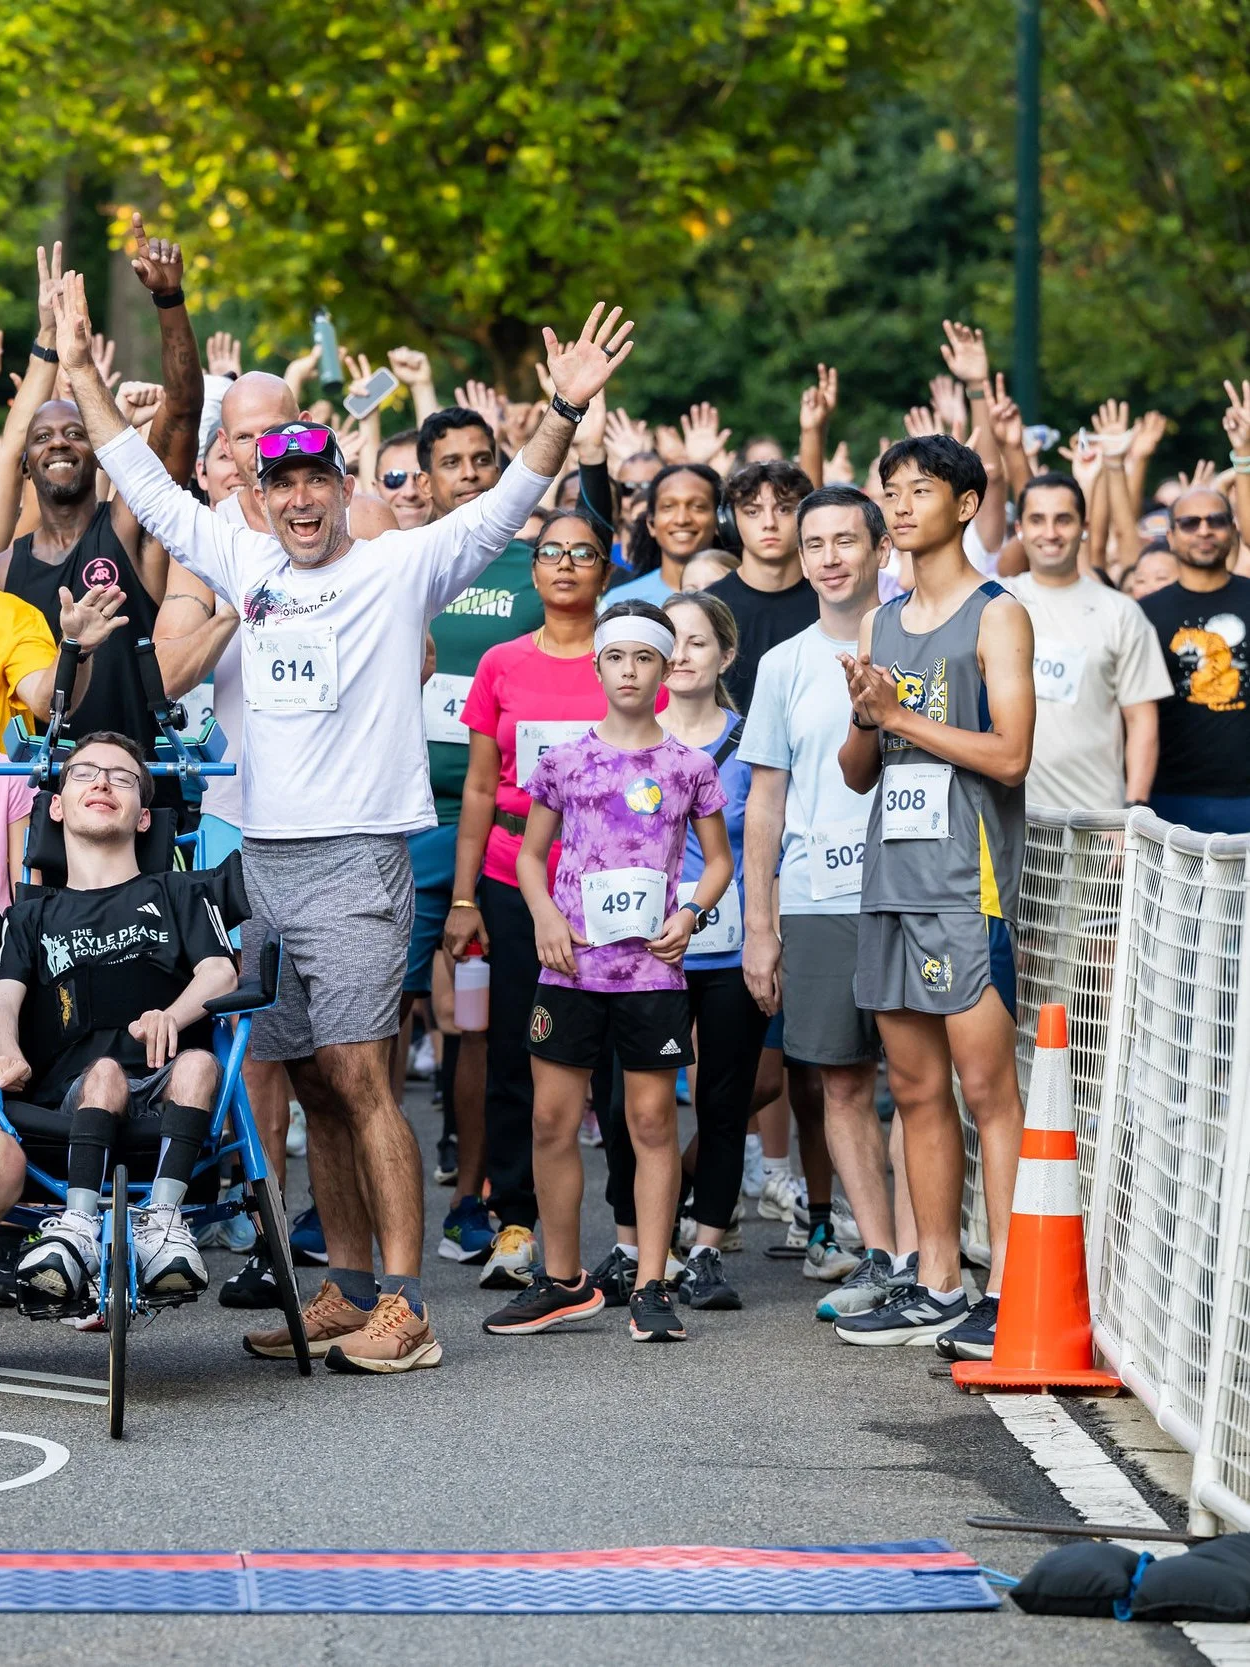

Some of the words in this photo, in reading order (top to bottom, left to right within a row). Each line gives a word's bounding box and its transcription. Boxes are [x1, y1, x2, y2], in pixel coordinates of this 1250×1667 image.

[271, 659, 315, 682] 614
[1035, 658, 1065, 679] 00
[294, 697, 308, 705] COX
[886, 788, 926, 812] 308
[825, 842, 867, 870] 502
[602, 890, 647, 914] 497
[71, 929, 93, 937] THE
[72, 934, 115, 950] KYLE
[118, 924, 169, 943] PEASE
[75, 935, 141, 958] FOUNDATION
